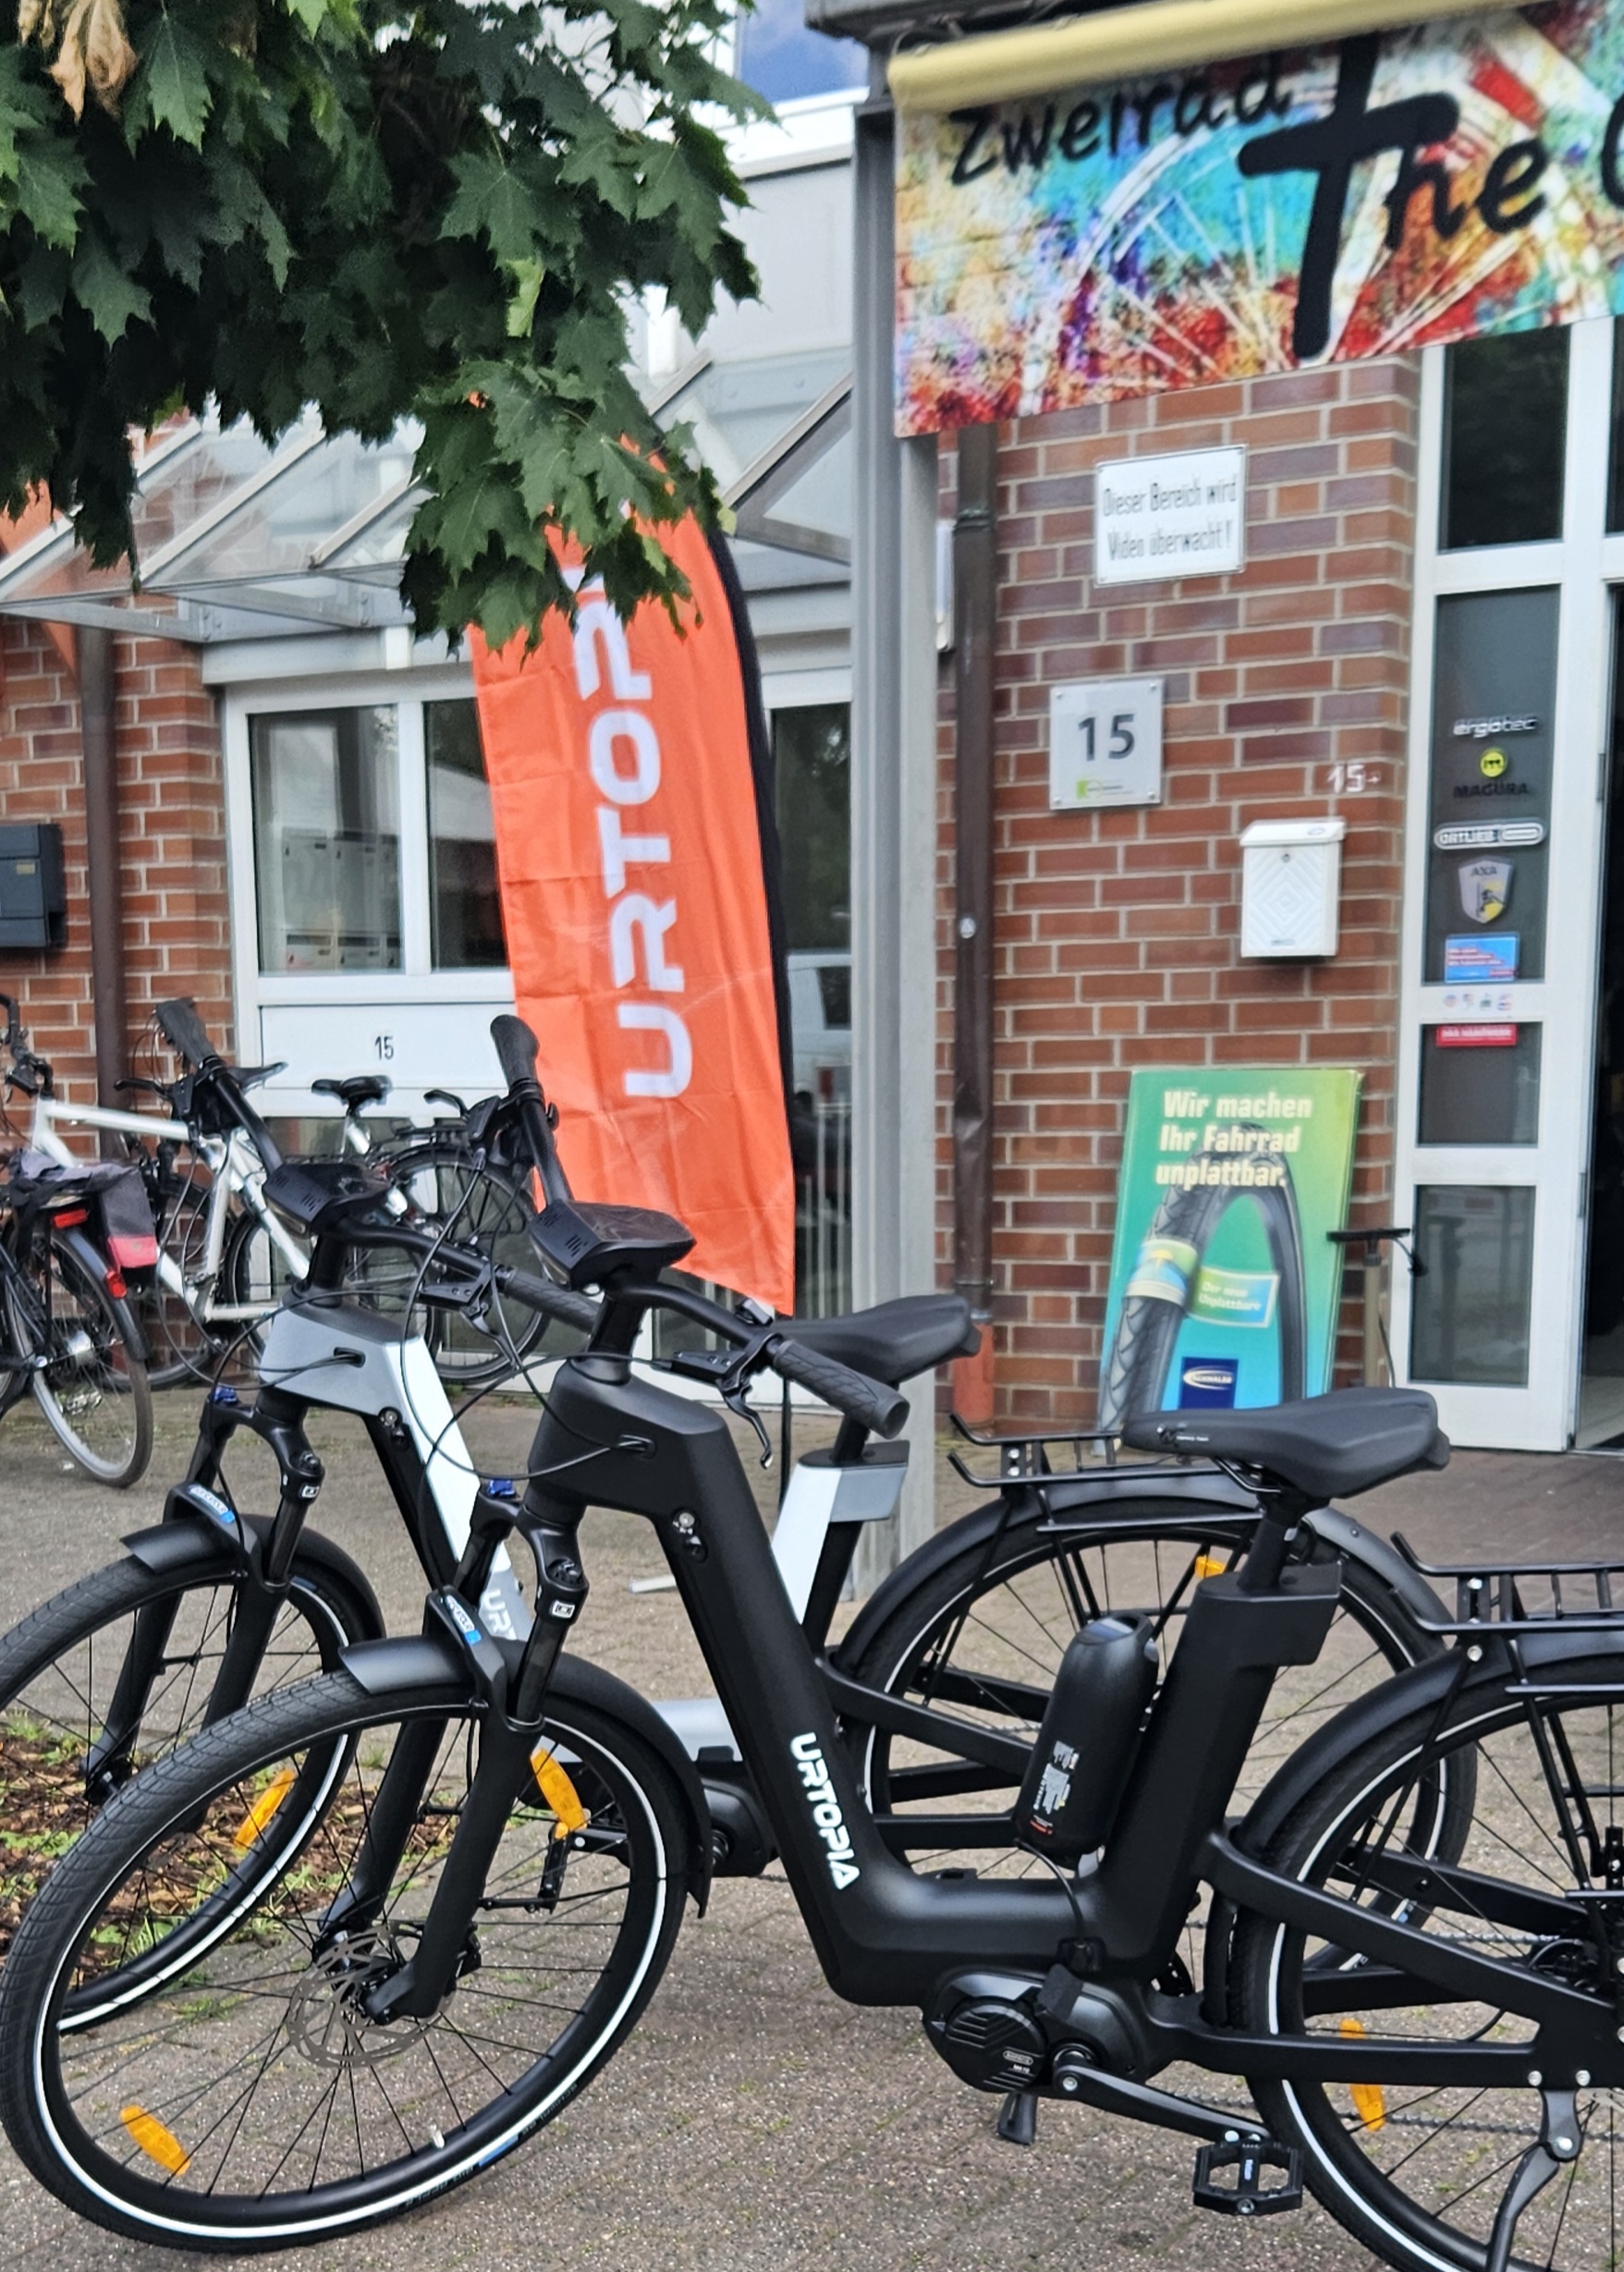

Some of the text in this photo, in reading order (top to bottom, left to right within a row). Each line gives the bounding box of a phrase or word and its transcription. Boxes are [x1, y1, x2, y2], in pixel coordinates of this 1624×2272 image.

[949, 46, 1296, 186] Zweirad
[1103, 474, 1237, 516] Dieser Bereich wird
[1078, 714, 1135, 762] 15
[1453, 715, 1537, 739] ergotec
[1453, 782, 1529, 798] MAGURA
[1471, 865, 1497, 876] AXA
[374, 1034, 395, 1060] 15
[1164, 1090, 1313, 1118] Wir machen
[1159, 1124, 1301, 1153] Ihr Fahrrad
[1154, 1158, 1287, 1191] unplattbar.
[789, 1731, 861, 1890] URTOPIA
